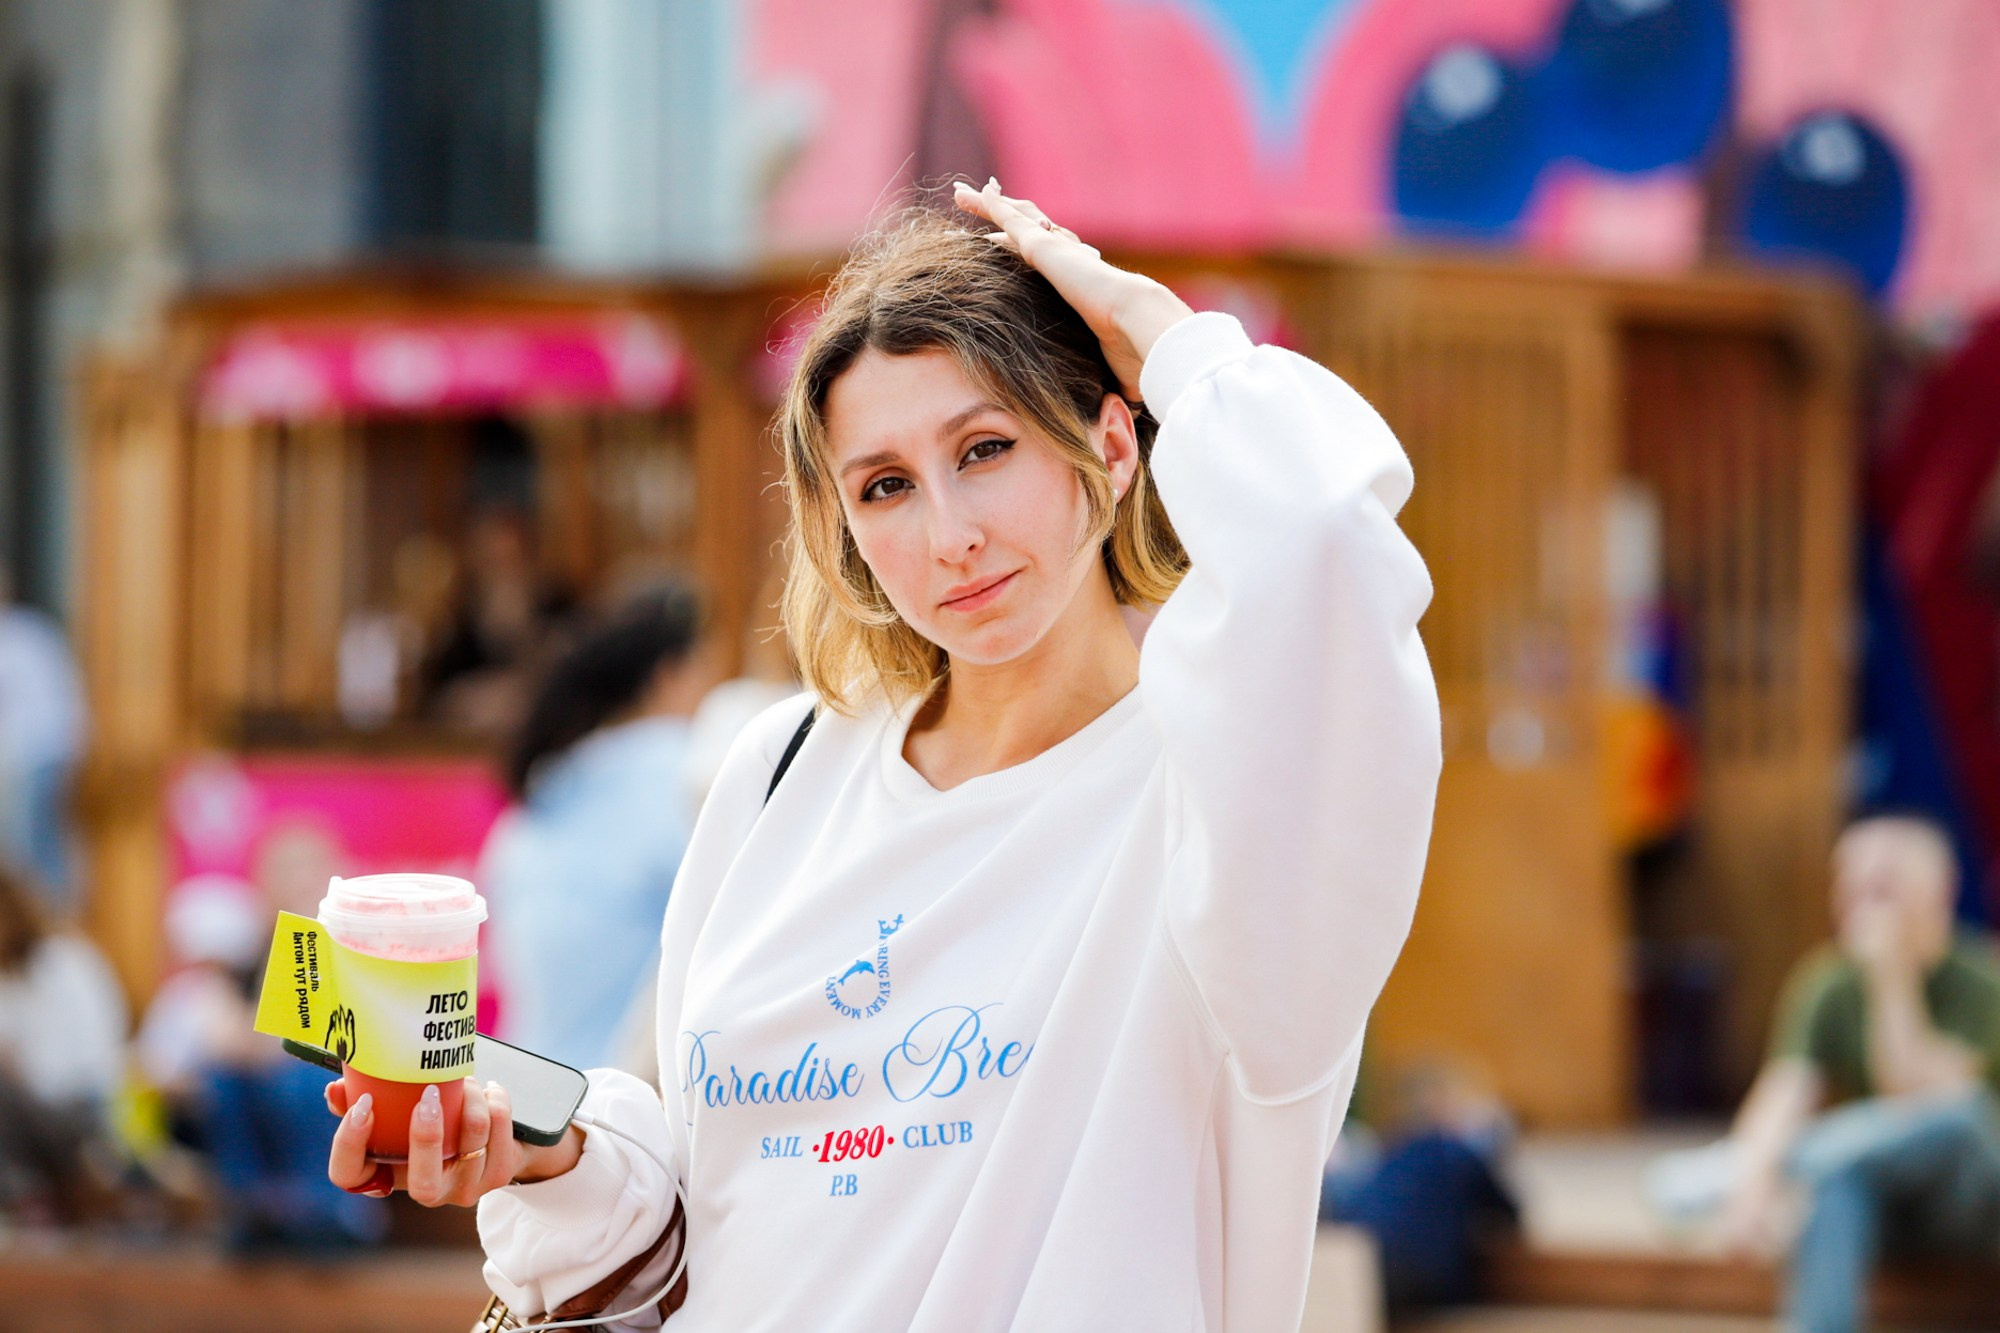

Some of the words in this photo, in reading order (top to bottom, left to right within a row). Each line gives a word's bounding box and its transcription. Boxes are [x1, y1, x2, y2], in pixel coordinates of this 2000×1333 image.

[293, 932, 305, 965] Антон
[306, 931, 319, 993] Фестиваль
[294, 966, 307, 986] тут
[295, 988, 311, 1030] рядом
[425, 989, 468, 1015] ЛЕТО
[865, 981, 891, 1018] EVERY
[682, 1030, 865, 1108] Paradise
[882, 1002, 1037, 1102] Bre
[761, 1136, 804, 1159] SAIL
[902, 1120, 974, 1149] CLUB
[830, 1173, 859, 1197] P.B
